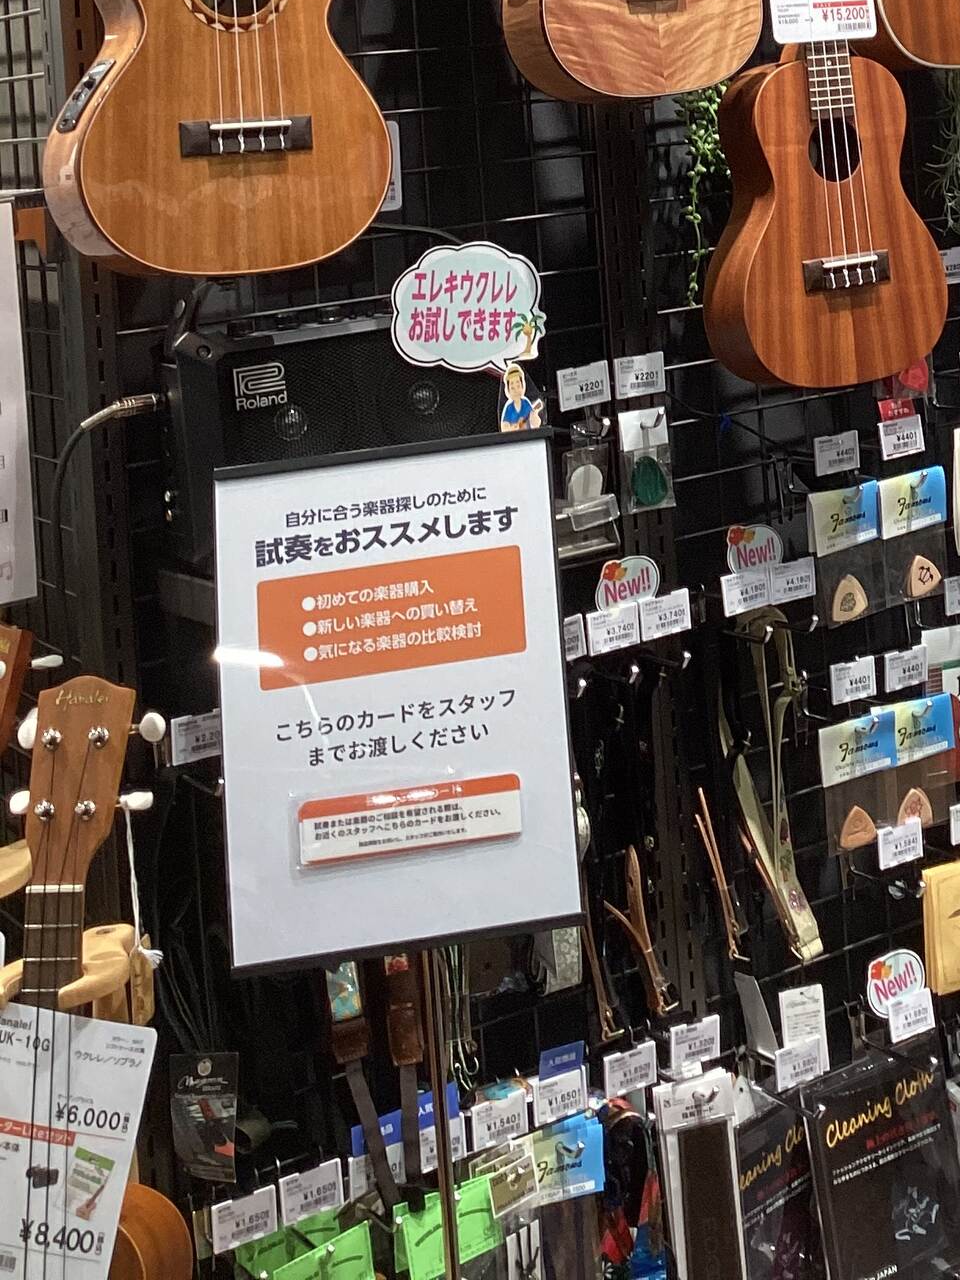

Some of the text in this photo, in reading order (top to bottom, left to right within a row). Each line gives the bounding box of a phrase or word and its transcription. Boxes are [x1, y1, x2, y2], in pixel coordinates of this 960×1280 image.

[822, 6, 866, 22] ¥15,200
[411, 270, 517, 304] エレキウクレレ
[408, 306, 517, 343] お試しできます
[236, 391, 288, 411] Roland
[285, 487, 487, 528] 自分に合う楽器探しのために
[255, 506, 519, 568] 試奏をおススメします
[735, 541, 776, 568] New!!
[316, 579, 434, 609] 初めての楽器購入
[604, 566, 650, 606] New!!
[317, 598, 479, 636] 新しい楽器への買い替え
[318, 621, 482, 661] 気になる楽器の比較検討
[275, 688, 517, 743] こちらのカードをスタッフ
[308, 723, 490, 767] までお渡しください
[874, 961, 918, 1004] New!!
[55, 1101, 121, 1131] ¥6,000
[826, 1096, 893, 1149] Cleaning
[20, 1218, 95, 1254] ¥8,400
